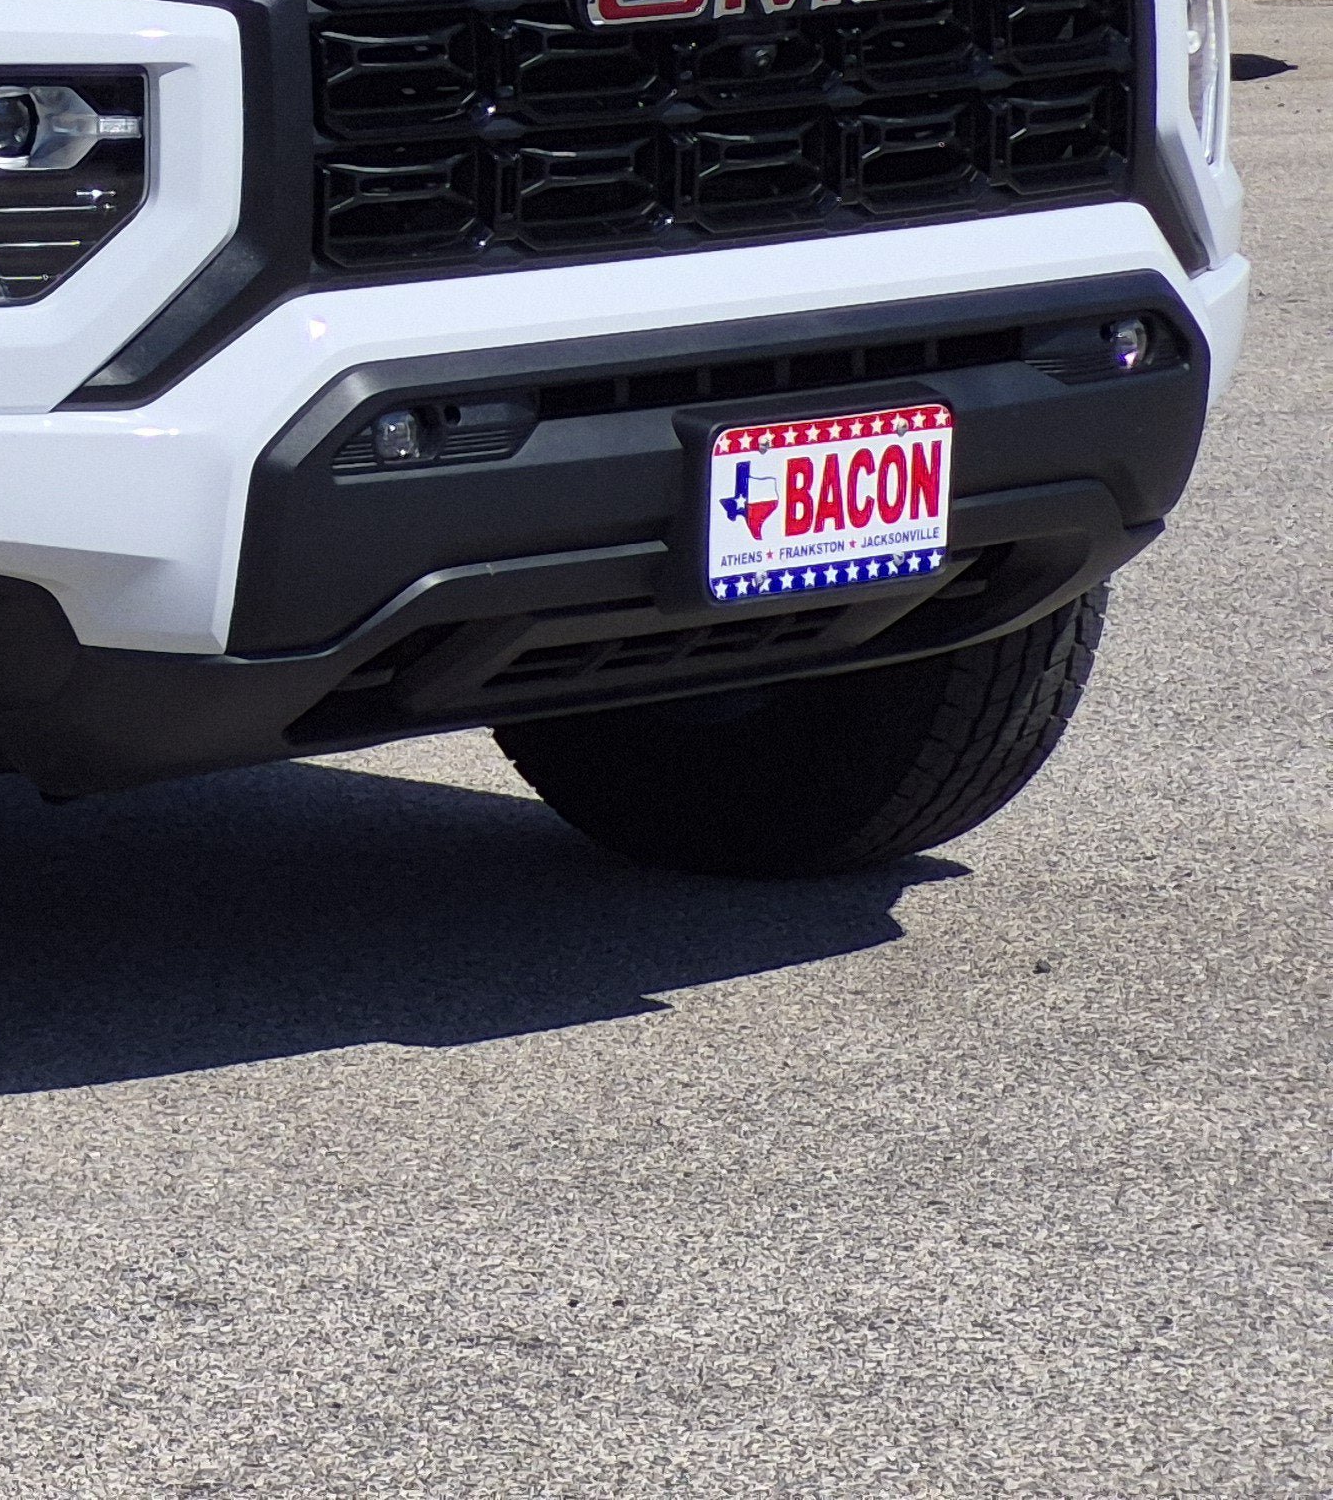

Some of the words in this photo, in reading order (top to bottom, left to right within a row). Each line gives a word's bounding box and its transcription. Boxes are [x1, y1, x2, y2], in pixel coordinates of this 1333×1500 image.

[785, 441, 942, 537] BACON
[720, 550, 763, 567] ATHENS
[779, 539, 844, 561] FRANKSTON
[860, 527, 940, 549] JACKSONVILLE
